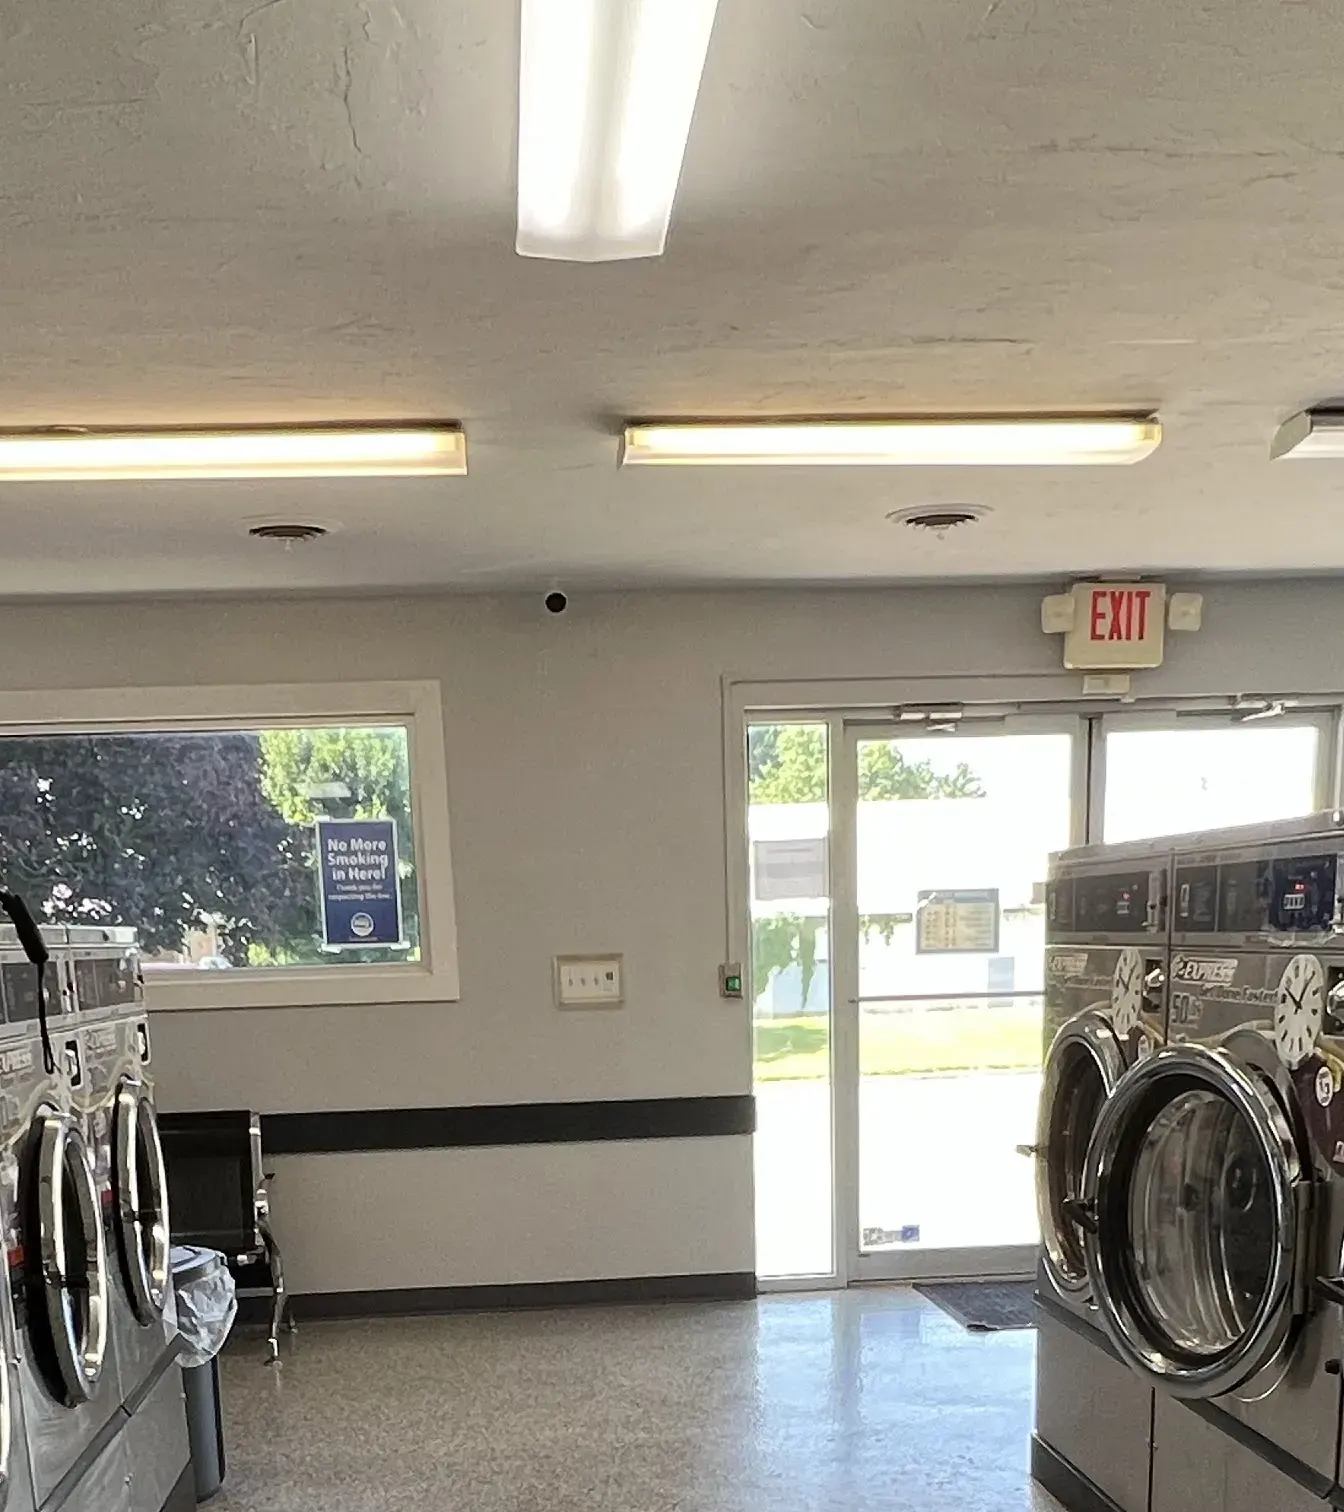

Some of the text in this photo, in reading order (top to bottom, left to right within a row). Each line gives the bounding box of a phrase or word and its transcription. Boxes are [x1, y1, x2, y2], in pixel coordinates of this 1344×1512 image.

[1090, 590, 1152, 641] EXIT
[327, 838, 387, 852] No More
[327, 851, 389, 868] Smoking
[332, 867, 346, 881] in
